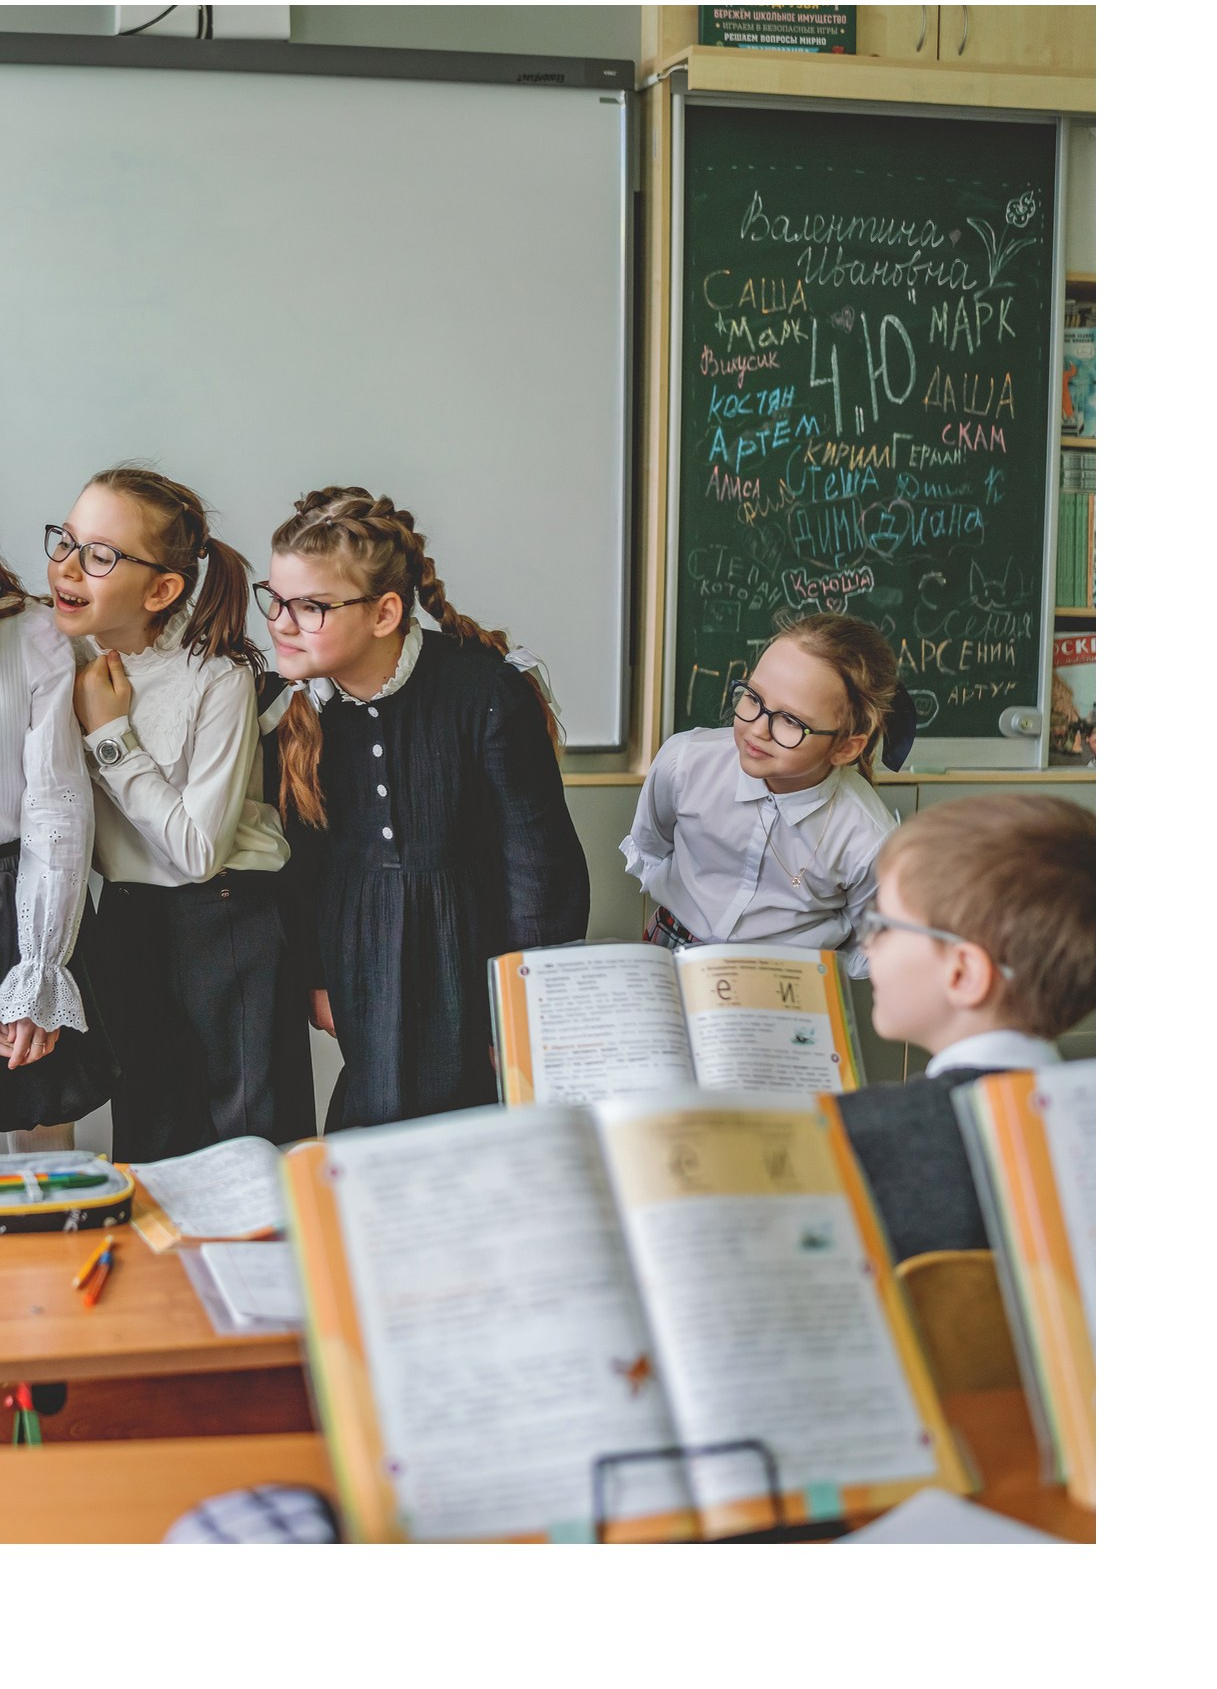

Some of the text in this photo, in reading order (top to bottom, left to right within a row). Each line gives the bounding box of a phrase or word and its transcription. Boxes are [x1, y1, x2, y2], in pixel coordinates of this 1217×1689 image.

[713, 8, 847, 25] БЕРЕЖЁМ ШКОЛЬНОЕ ИМУЩЕСТВО
[722, 21, 755, 32] ИГРАЕМ
[763, 24, 816, 34] БЕЗОПАСНЫЕ
[817, 26, 838, 35] ИГРЫ
[724, 32, 827, 46] РЕШАЕМ ВОПРОСЫ МИРНО
[740, 190, 945, 249] Валентина
[796, 245, 977, 291] Ивановна
[703, 270, 807, 315] САША
[929, 291, 1016, 355] МАРК
[707, 384, 795, 424] КОСТЯН
[923, 365, 1015, 420] ДАША
[942, 420, 1008, 454] СКАМ
[896, 638, 1017, 677] АРСЕНИЙ
